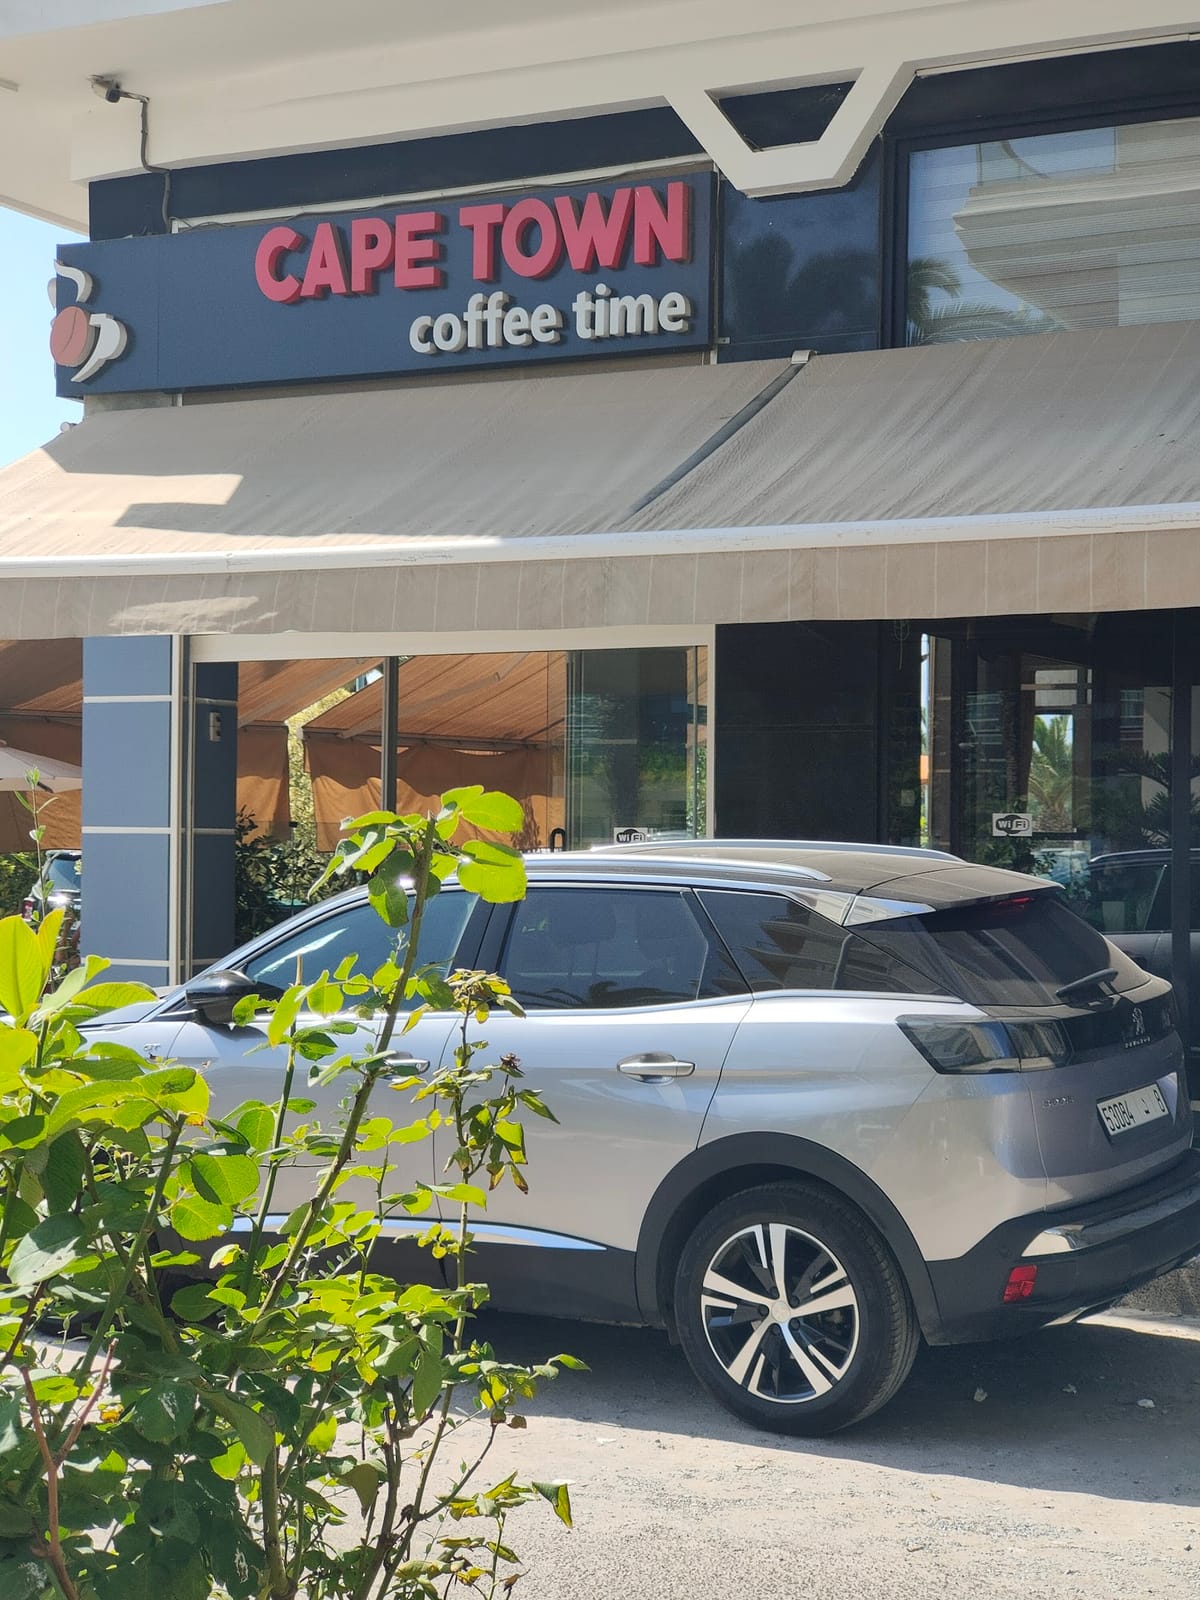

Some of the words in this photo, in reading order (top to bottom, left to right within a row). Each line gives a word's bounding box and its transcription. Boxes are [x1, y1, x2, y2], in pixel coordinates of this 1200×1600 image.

[255, 211, 443, 304] CAPE
[458, 181, 689, 281] TOWN
[408, 291, 563, 354] coffee
[571, 283, 691, 341] time
[1101, 1101, 1136, 1131] 53084
[1153, 1089, 1165, 1112] 8
